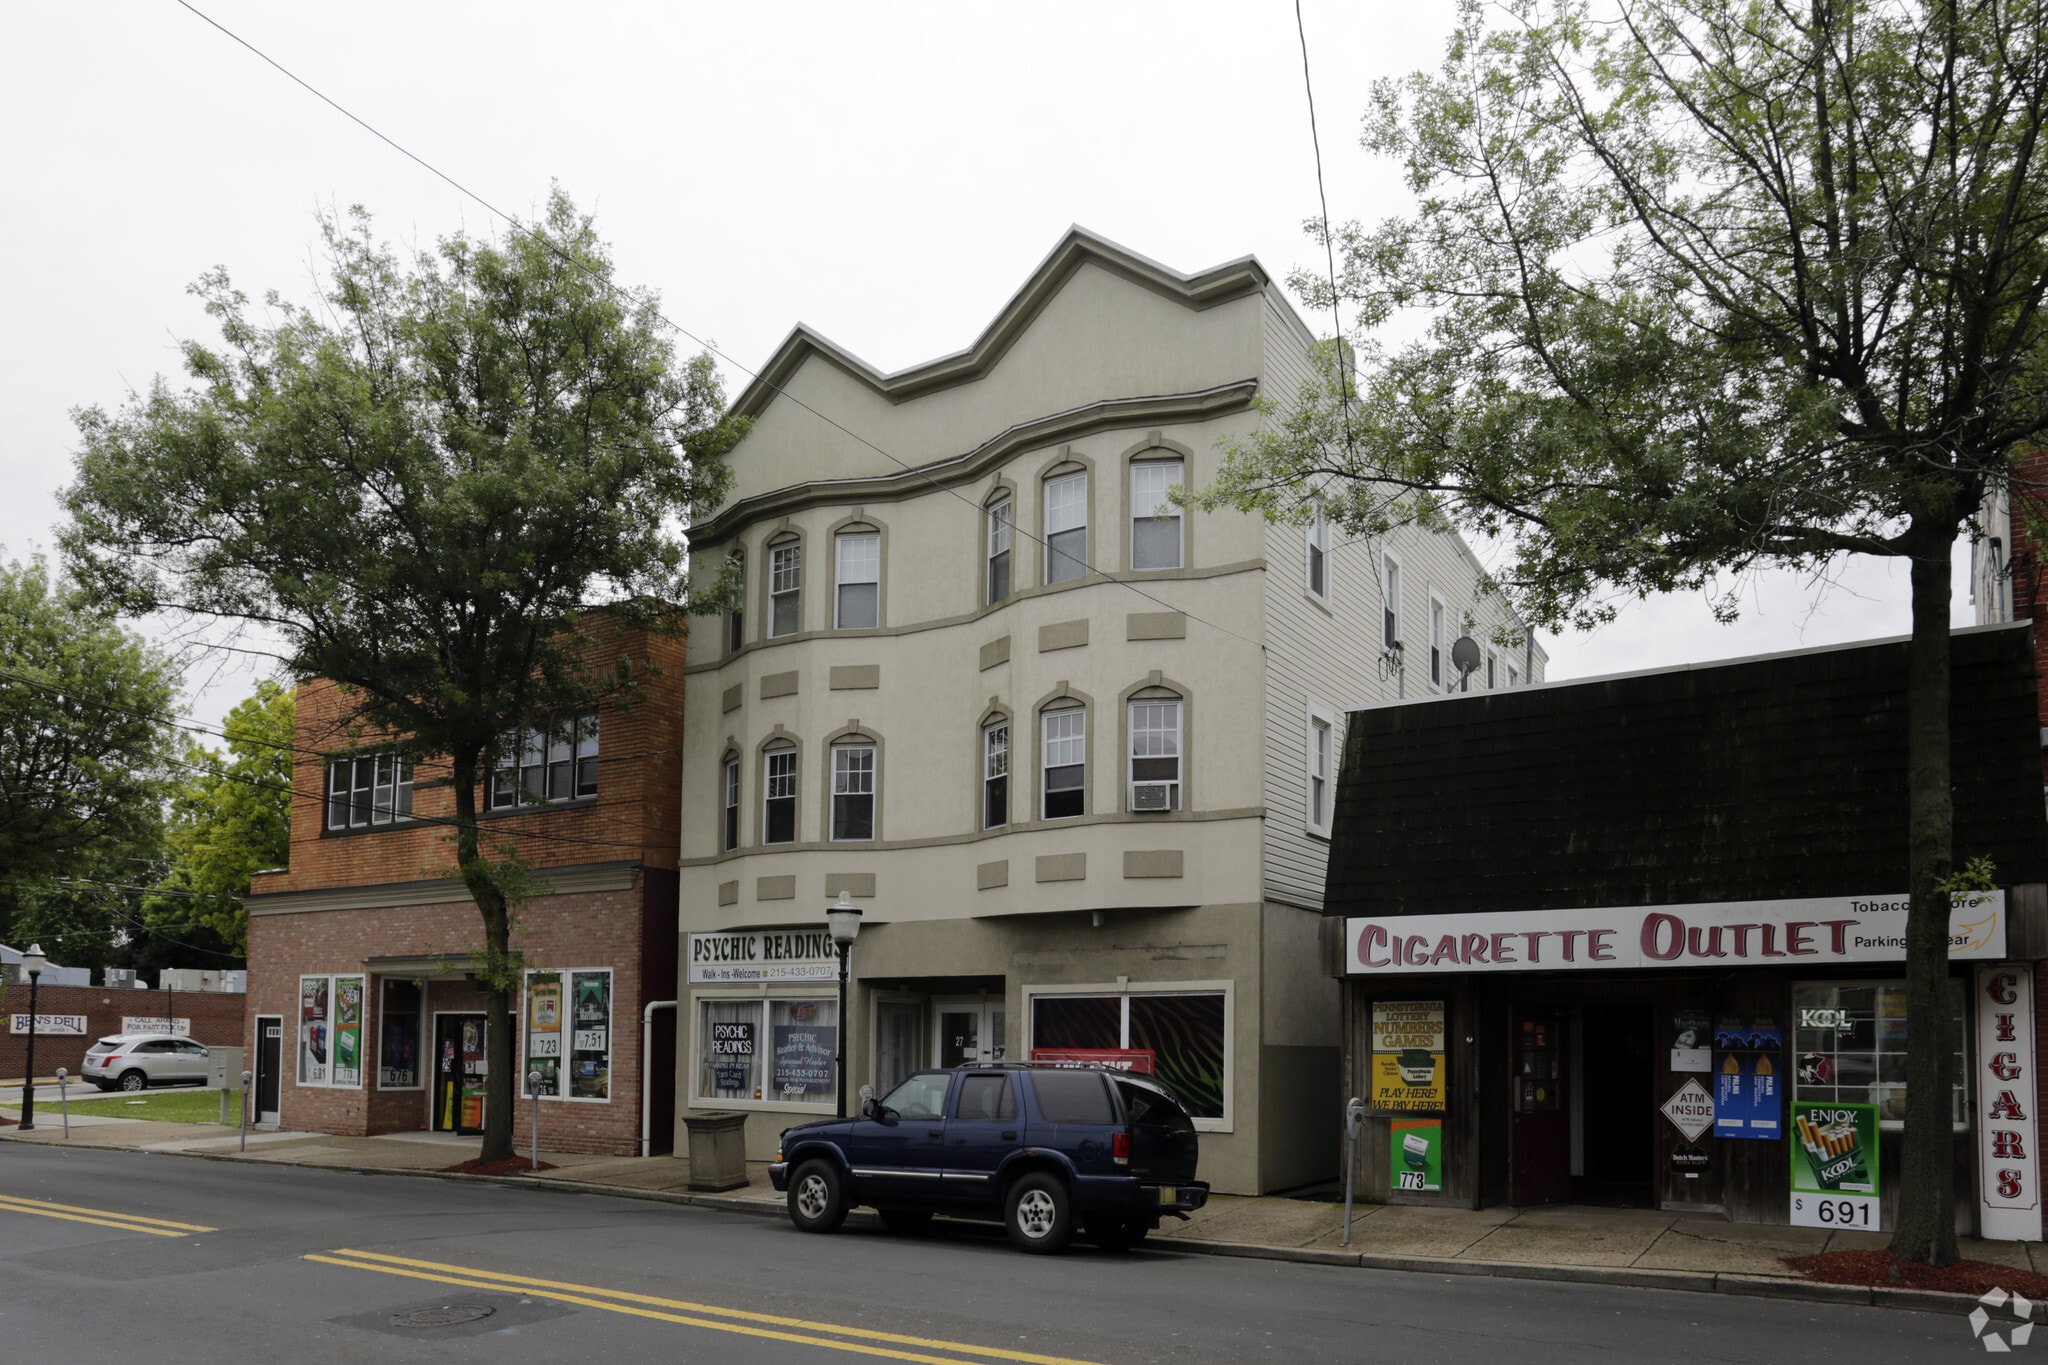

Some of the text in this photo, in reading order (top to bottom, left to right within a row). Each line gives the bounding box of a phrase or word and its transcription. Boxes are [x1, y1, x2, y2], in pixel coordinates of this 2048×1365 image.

[1850, 901, 1910, 913] Tobacc
[1357, 912, 1861, 967] CIGARETTE OUTLET
[1854, 936, 1969, 952] Parking ear
[694, 937, 756, 961] PSYCHIC
[703, 969, 716, 979] Walk
[770, 966, 832, 978] 215-433-0707
[1386, 1012, 1430, 1021] LOTTERY
[1801, 1009, 1853, 1029] KOOL
[16, 1016, 83, 1033] BEN'S DELI
[1373, 1022, 1444, 1035] NUMBERS
[715, 1025, 748, 1039] PSYCHIC
[788, 1033, 817, 1042] PSYCHIC
[540, 1040, 557, 1054] 7.23
[585, 1033, 602, 1049] 7.51
[713, 1040, 752, 1054] READINGS
[1382, 1035, 1435, 1047] GAMES
[798, 1043, 804, 1051] &
[805, 1043, 832, 1056] Advisor
[777, 1069, 830, 1077] 215-433-0707
[783, 1083, 807, 1095] Special
[1986, 973, 2026, 1198] CIGARS
[1379, 1088, 1438, 1099] PLAY HERE!
[1680, 1093, 1705, 1104] ATM
[1373, 1100, 1444, 1110] WE PAY HERE!
[1671, 1105, 1713, 1116] INSIDE
[1821, 1157, 1858, 1181] KOOL
[1401, 1172, 1424, 1189] 773
[1795, 1199, 1869, 1225] $ 6.91
